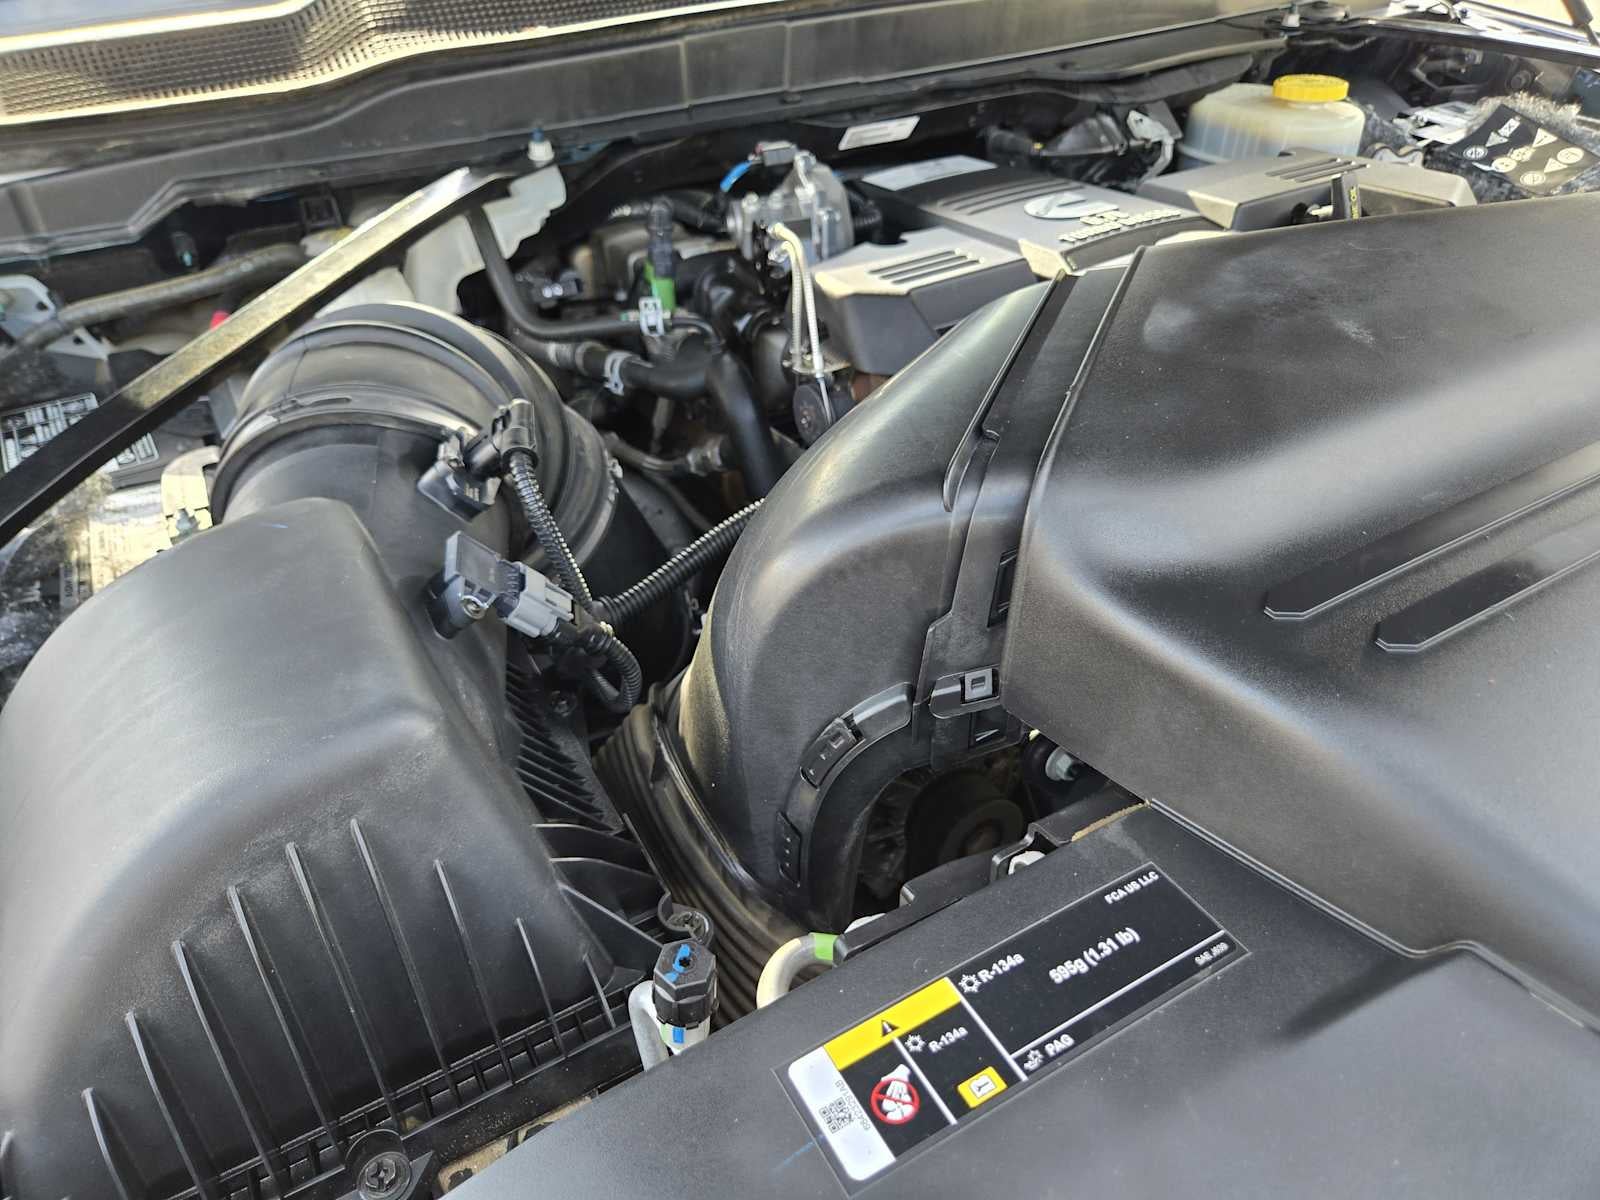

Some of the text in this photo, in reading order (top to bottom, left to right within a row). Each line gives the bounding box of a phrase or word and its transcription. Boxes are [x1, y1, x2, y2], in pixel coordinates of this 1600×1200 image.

[1104, 871, 1159, 904] FCA US LLC
[1083, 937, 1119, 967] (1.31
[1114, 927, 1140, 946] lb)
[977, 953, 1025, 983] R-134a
[928, 1026, 969, 1053] R-134a
[1044, 1033, 1076, 1057] PAG
